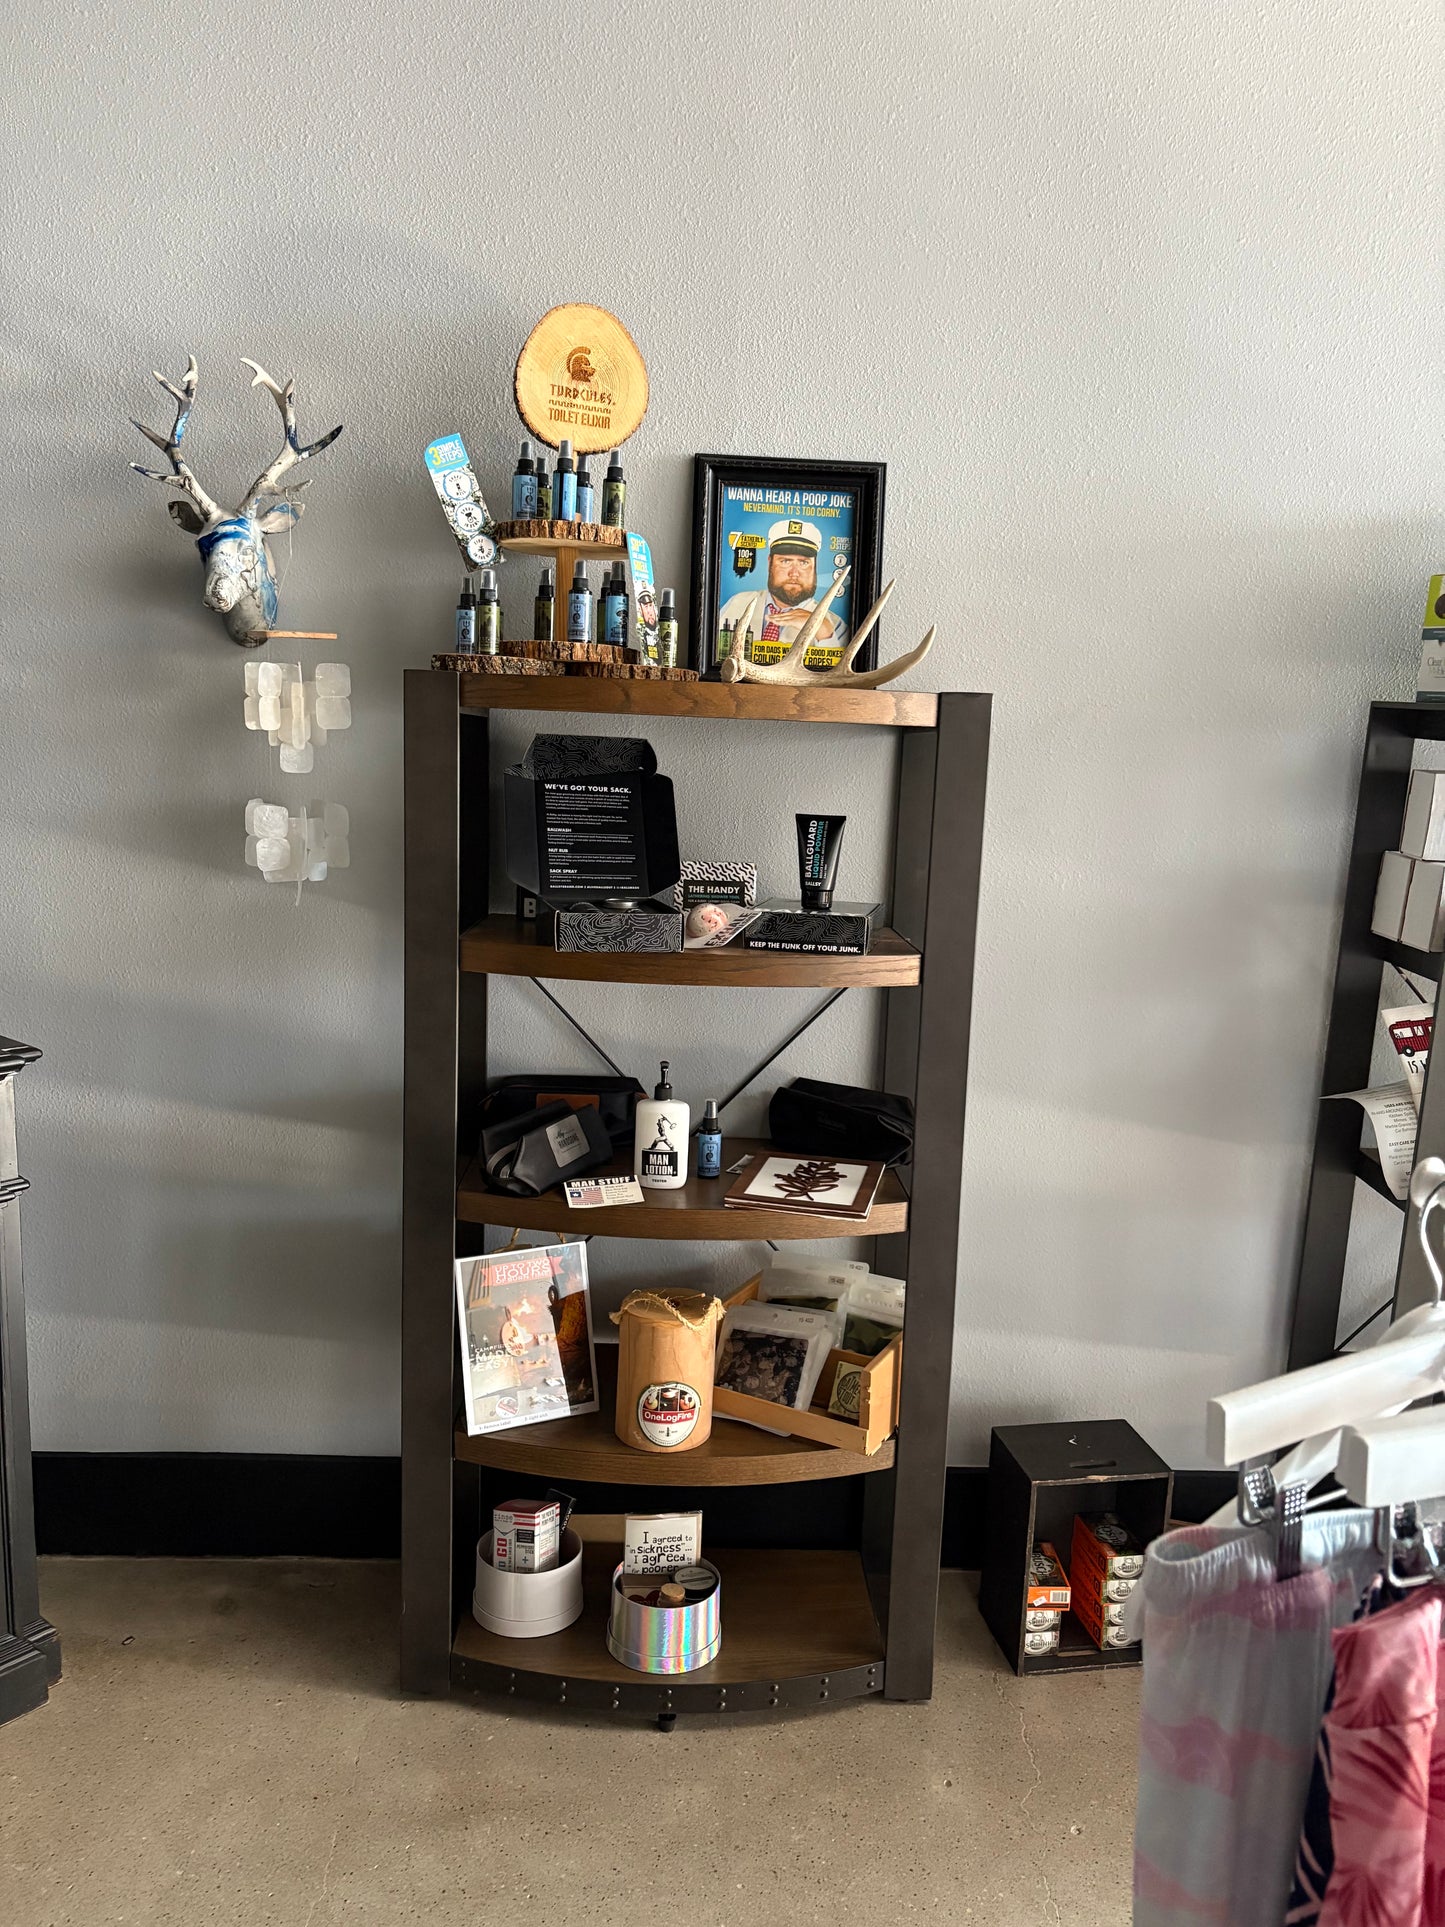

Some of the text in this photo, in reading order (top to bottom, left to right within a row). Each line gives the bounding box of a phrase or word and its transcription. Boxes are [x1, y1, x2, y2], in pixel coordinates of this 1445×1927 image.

[548, 407, 611, 429] TOILET ELIXIR
[428, 440, 460, 466] 3 SIMPLE
[727, 486, 763, 502] WANNA
[765, 490, 791, 504] HEAR
[793, 491, 800, 505] A
[802, 492, 828, 507] POOP
[787, 505, 801, 516] IT'S
[802, 506, 815, 517] TOO
[816, 508, 841, 518] CORNY.
[729, 531, 743, 551] 7
[830, 536, 837, 550] 3
[738, 549, 754, 559] 100+
[754, 645, 765, 654] FOR
[766, 645, 781, 655] DADS
[810, 648, 827, 657] GOOD
[826, 649, 843, 658] JOKES
[753, 653, 781, 665] COILING
[544, 783, 569, 791] WE'VE
[587, 785, 609, 793] YOUR
[610, 786, 632, 794] SACK.
[815, 821, 825, 852] POWDER
[805, 820, 818, 878] BALLGUARD
[812, 853, 821, 879] LIQUID
[688, 885, 740, 894] THE HANDY
[749, 940, 767, 948] KEEP
[767, 941, 780, 949] THE
[781, 942, 801, 950] FUNK
[817, 944, 838, 952] YOUR
[838, 945, 861, 953] JUNK.
[1407, 1060, 1419, 1074] IS
[649, 1154, 669, 1165] MAN
[571, 1176, 631, 1188] MAN STUFF
[495, 1258, 550, 1273] UP TO TWO
[496, 1264, 551, 1281] HOURS
[643, 1531, 650, 1544] I
[652, 1534, 683, 1545] agreed
[496, 1537, 508, 1558] GO
[634, 1555, 639, 1564] I
[642, 1552, 686, 1566] agreed
